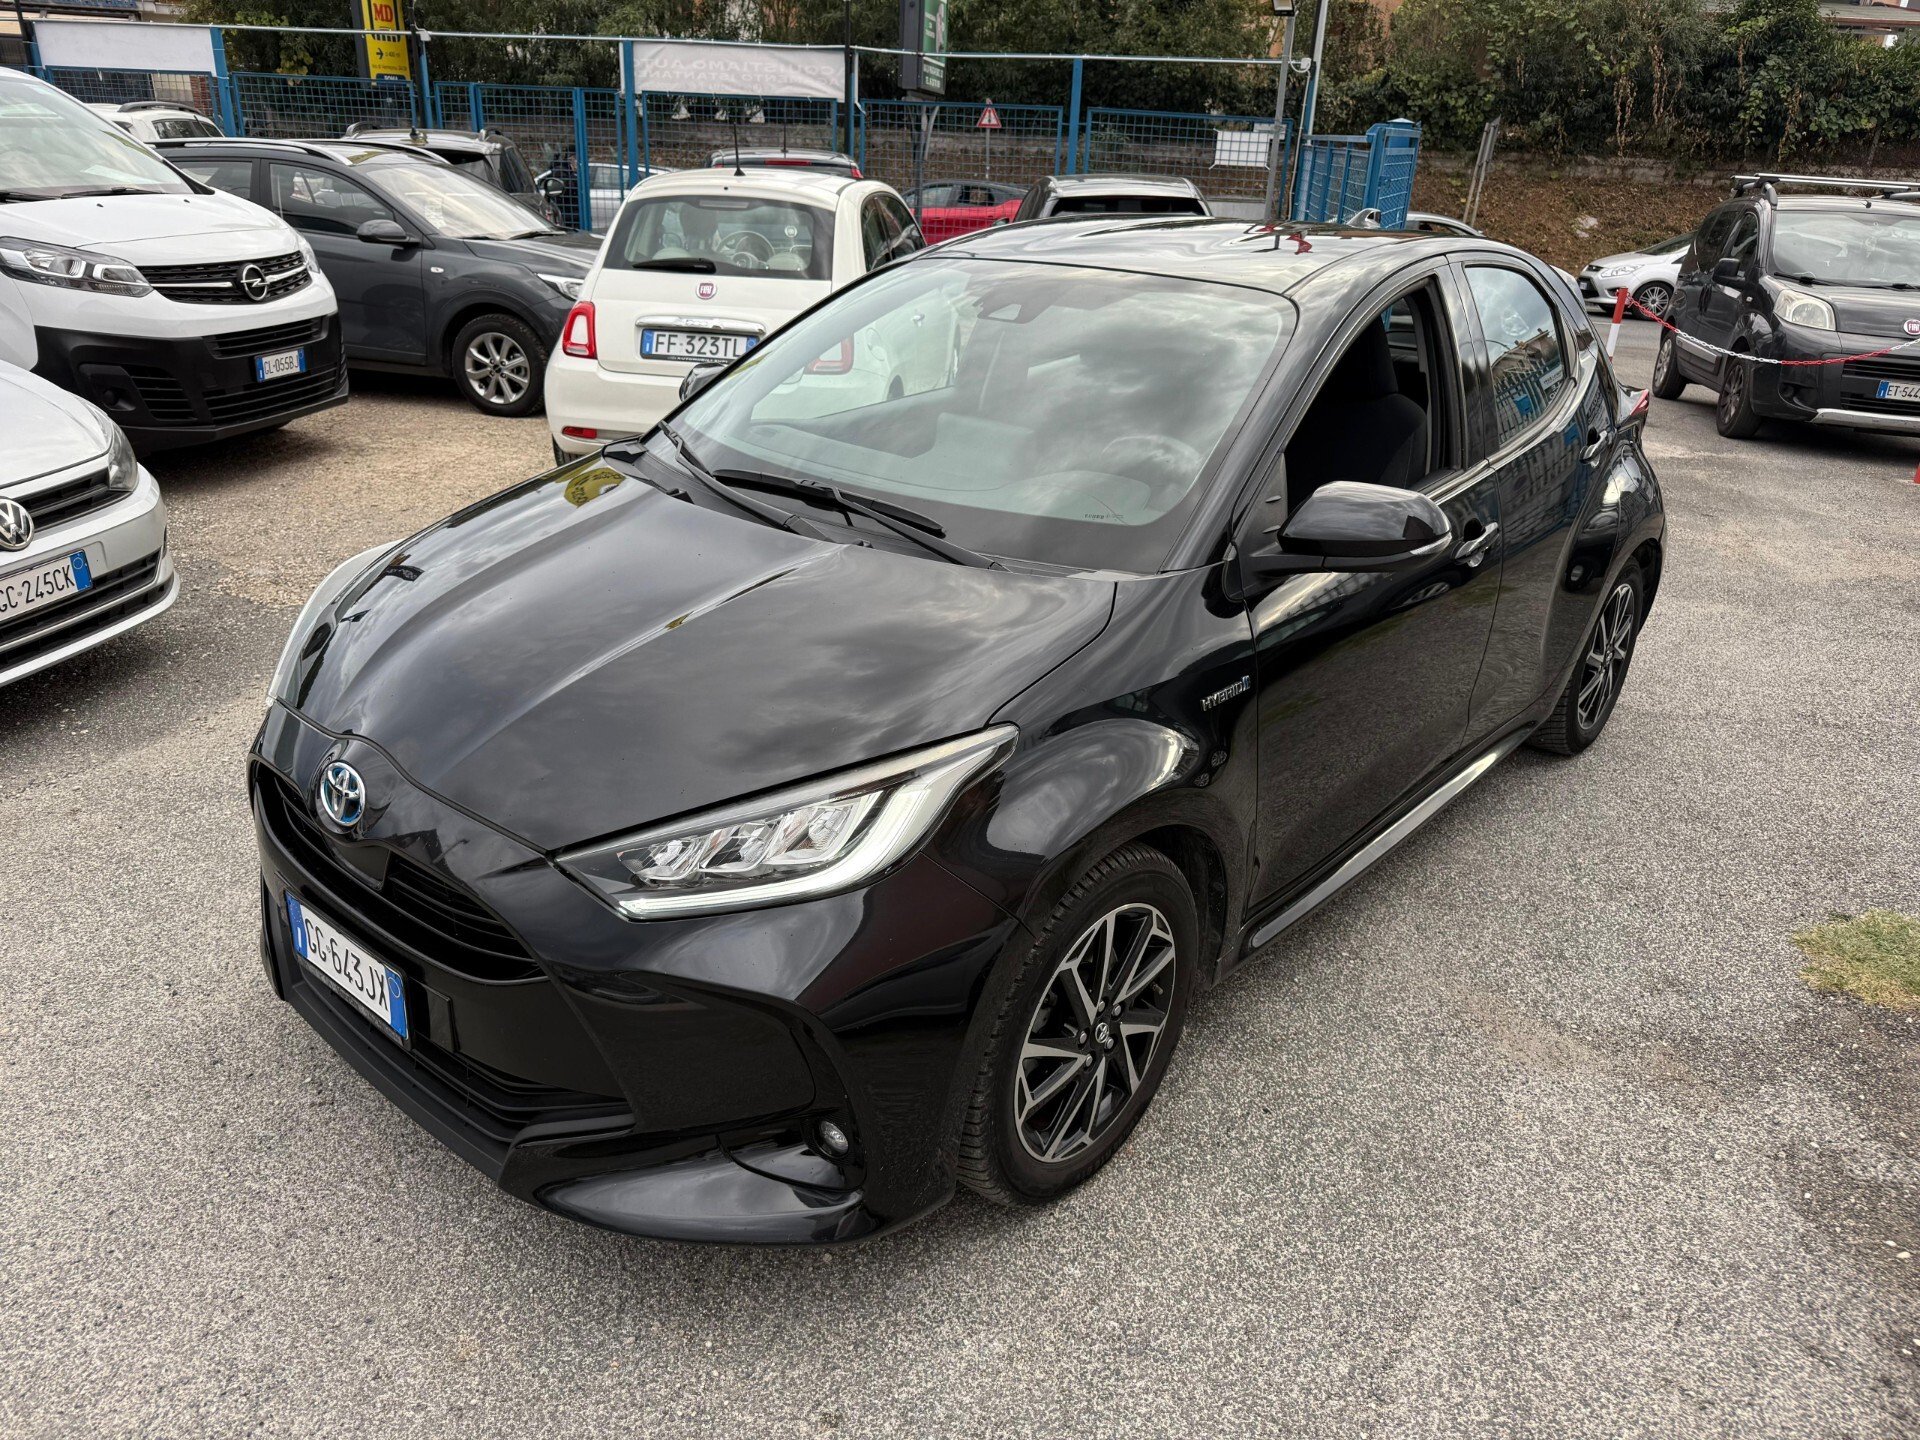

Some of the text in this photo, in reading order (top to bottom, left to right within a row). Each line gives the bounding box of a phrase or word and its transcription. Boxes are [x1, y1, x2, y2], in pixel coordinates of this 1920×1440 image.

[373, 3, 394, 22] MD
[700, 285, 713, 294] FIAT
[655, 334, 678, 353] FF
[685, 335, 743, 358] 323TL
[1901, 386, 1920, 398] 544
[22, 564, 75, 604] 245CK
[1201, 681, 1242, 711] HYBRID
[329, 937, 389, 1012] 643JX
